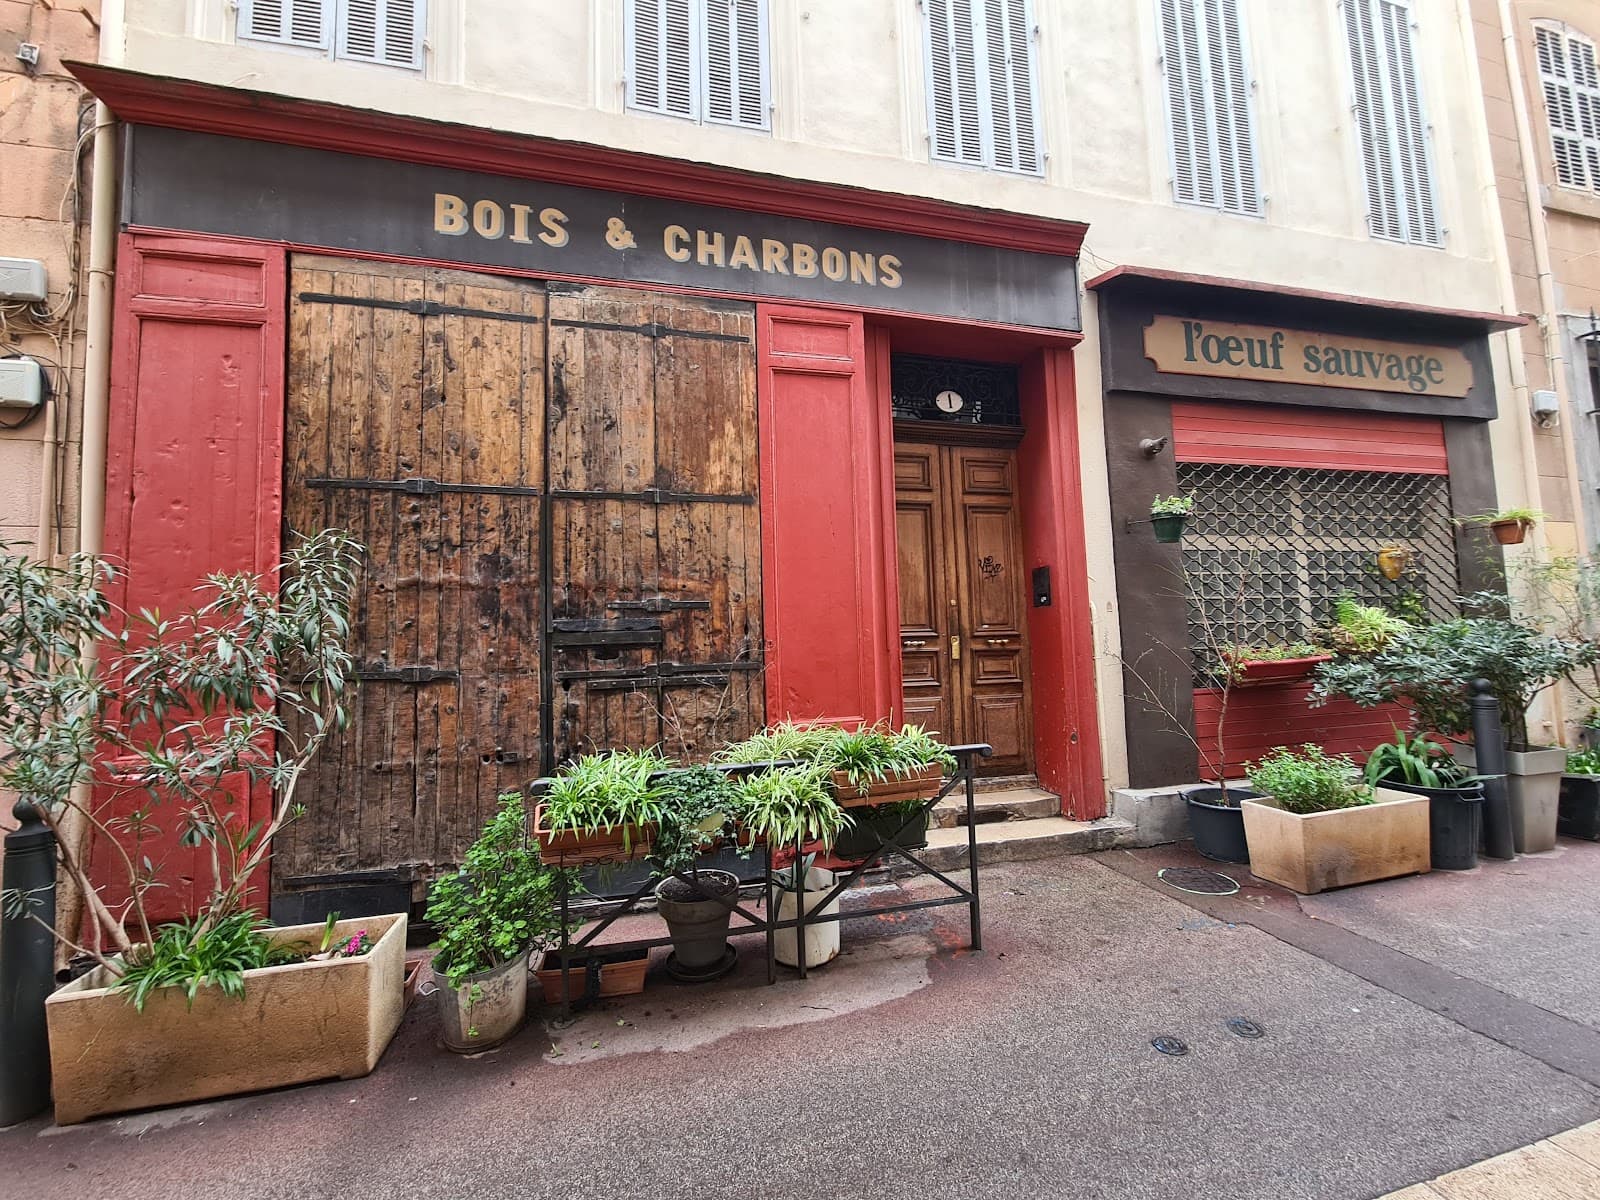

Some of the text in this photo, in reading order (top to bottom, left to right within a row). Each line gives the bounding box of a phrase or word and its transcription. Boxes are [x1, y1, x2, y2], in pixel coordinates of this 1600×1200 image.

[433, 193, 903, 288] BOIS & CHARBONS
[1303, 345, 1444, 392] sauvage
